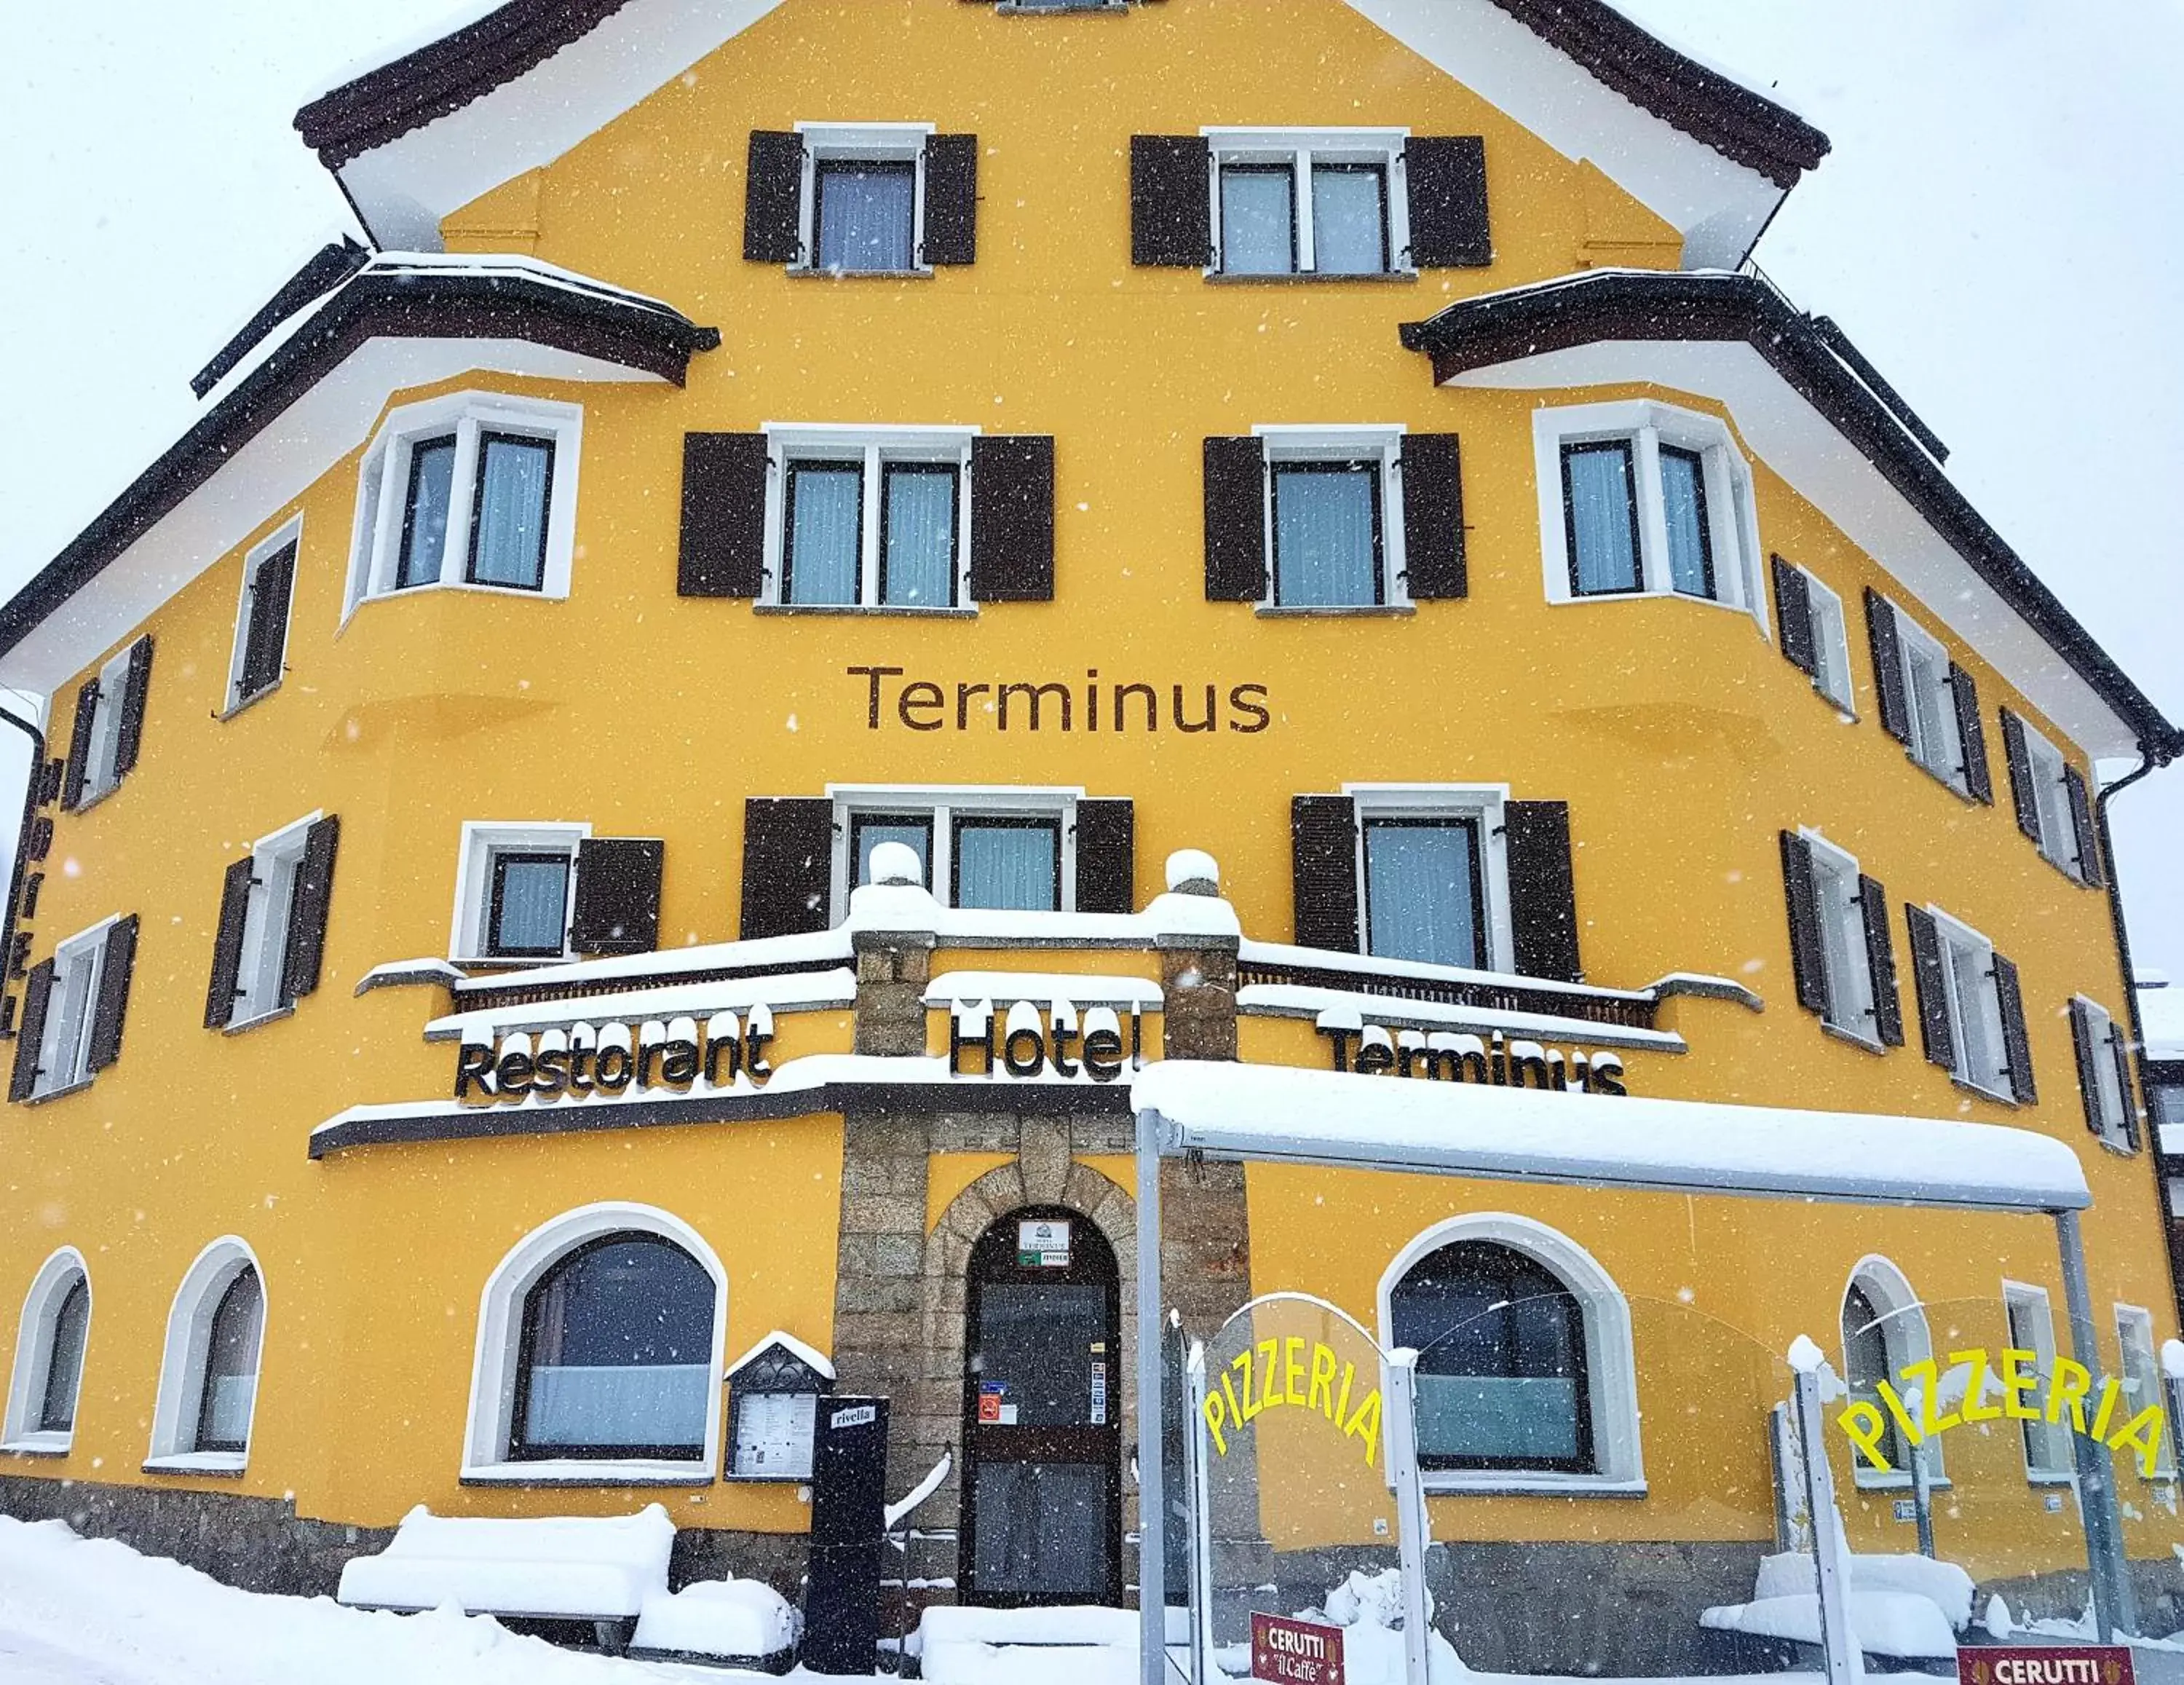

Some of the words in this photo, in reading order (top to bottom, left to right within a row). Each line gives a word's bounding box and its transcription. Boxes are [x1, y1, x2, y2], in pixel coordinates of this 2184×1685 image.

[847, 666, 1271, 733] Terminus
[454, 1022, 773, 1098] Restorant
[951, 1015, 1141, 1082] Hotel
[1315, 1026, 1628, 1097] Terminus
[836, 1409, 870, 1424] rivella
[1203, 1337, 1382, 1468] PIZZERIA
[1837, 1348, 2164, 1480] PIZZERIA
[1269, 1627, 1324, 1660] CERUTTI
[1995, 1660, 2100, 1684] CERUTTI
